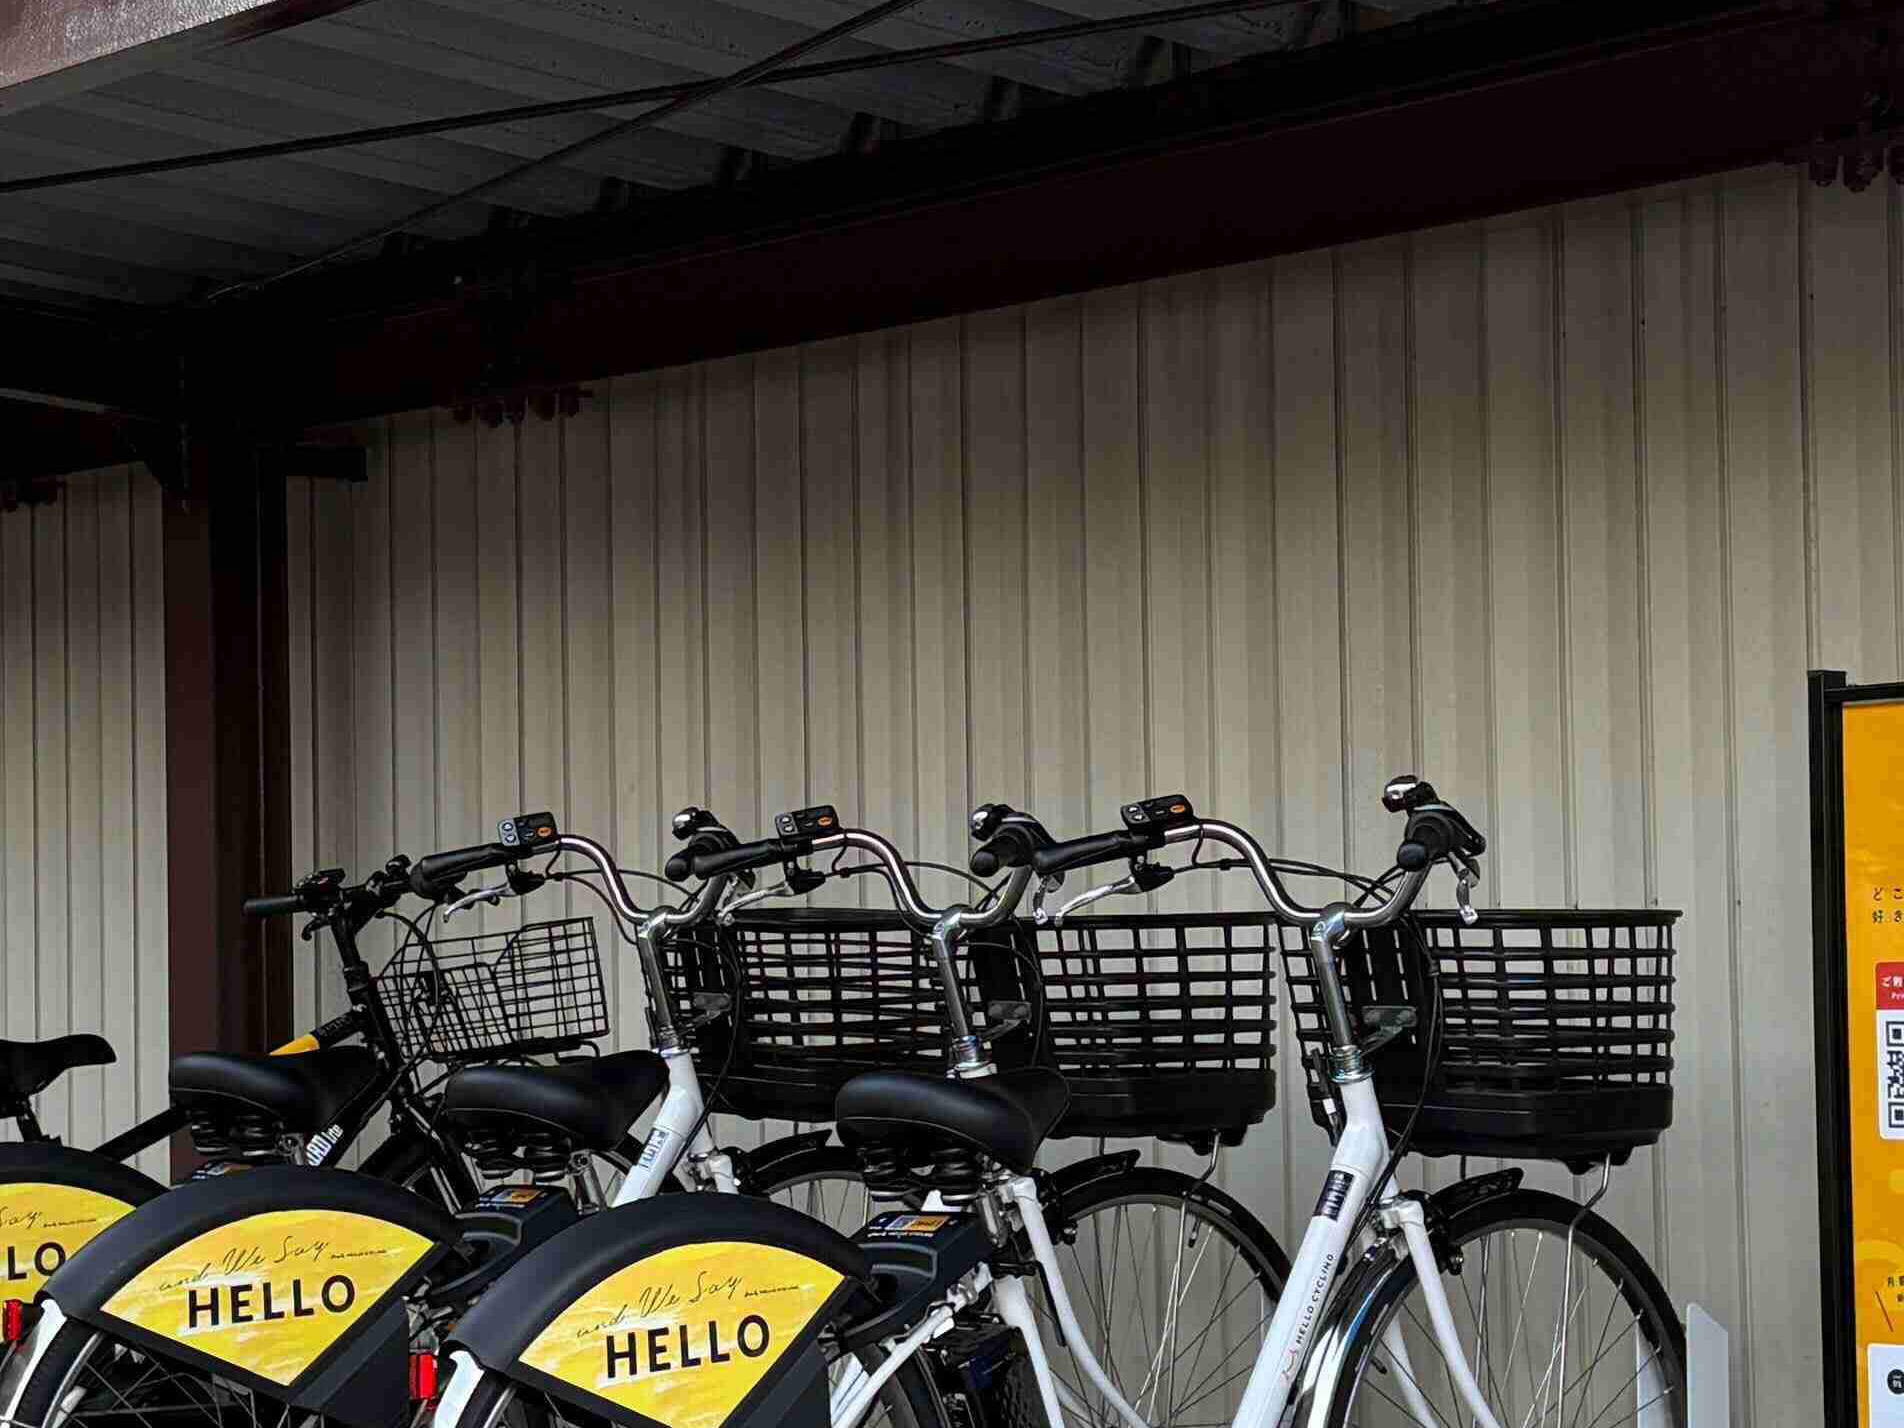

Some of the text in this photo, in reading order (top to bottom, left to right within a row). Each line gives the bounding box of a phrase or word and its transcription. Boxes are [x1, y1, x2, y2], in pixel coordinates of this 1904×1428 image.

[222, 1247, 265, 1275] We
[274, 1236, 330, 1263] Say
[188, 1275, 355, 1328] HELLO
[639, 1284, 680, 1317] We
[689, 1270, 742, 1303] Say
[1296, 1253, 1334, 1344] HELLO CYCLING
[606, 1314, 770, 1378] HELLO
